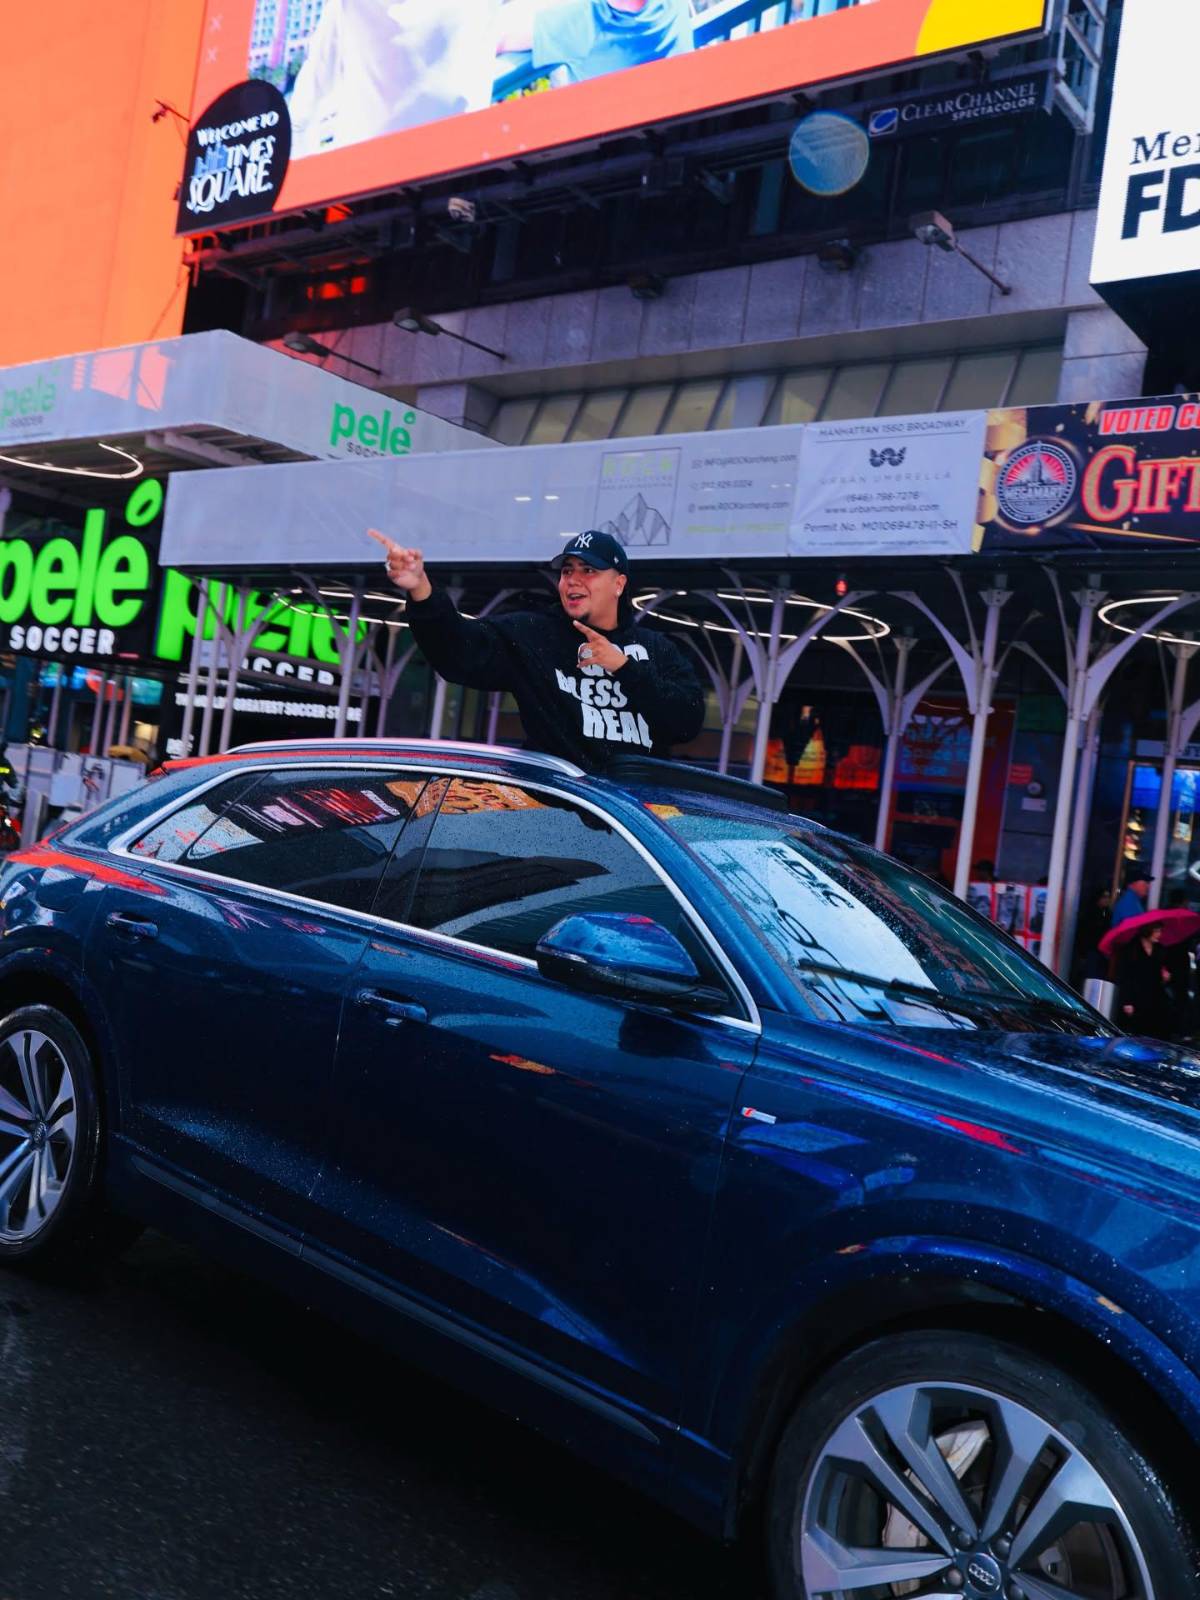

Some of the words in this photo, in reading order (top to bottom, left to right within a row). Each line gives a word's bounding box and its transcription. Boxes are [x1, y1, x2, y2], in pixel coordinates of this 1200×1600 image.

[952, 97, 1035, 121] SPECTACOLOR
[197, 116, 260, 147] WELCOME
[226, 135, 276, 169] TIMES
[186, 158, 273, 214] SQUARE
[820, 425, 879, 436] MANHATTAN
[907, 420, 966, 431] BROADWAY
[1098, 405, 1176, 435] VOTED
[1175, 403, 1200, 430] C
[825, 504, 940, 514] www.urbanumbrella.com
[804, 522, 837, 532] Permit
[9, 625, 116, 655] SOCCER
[241, 656, 336, 687] CCER
[326, 705, 362, 722] STRE
[581, 702, 653, 749] REAL
